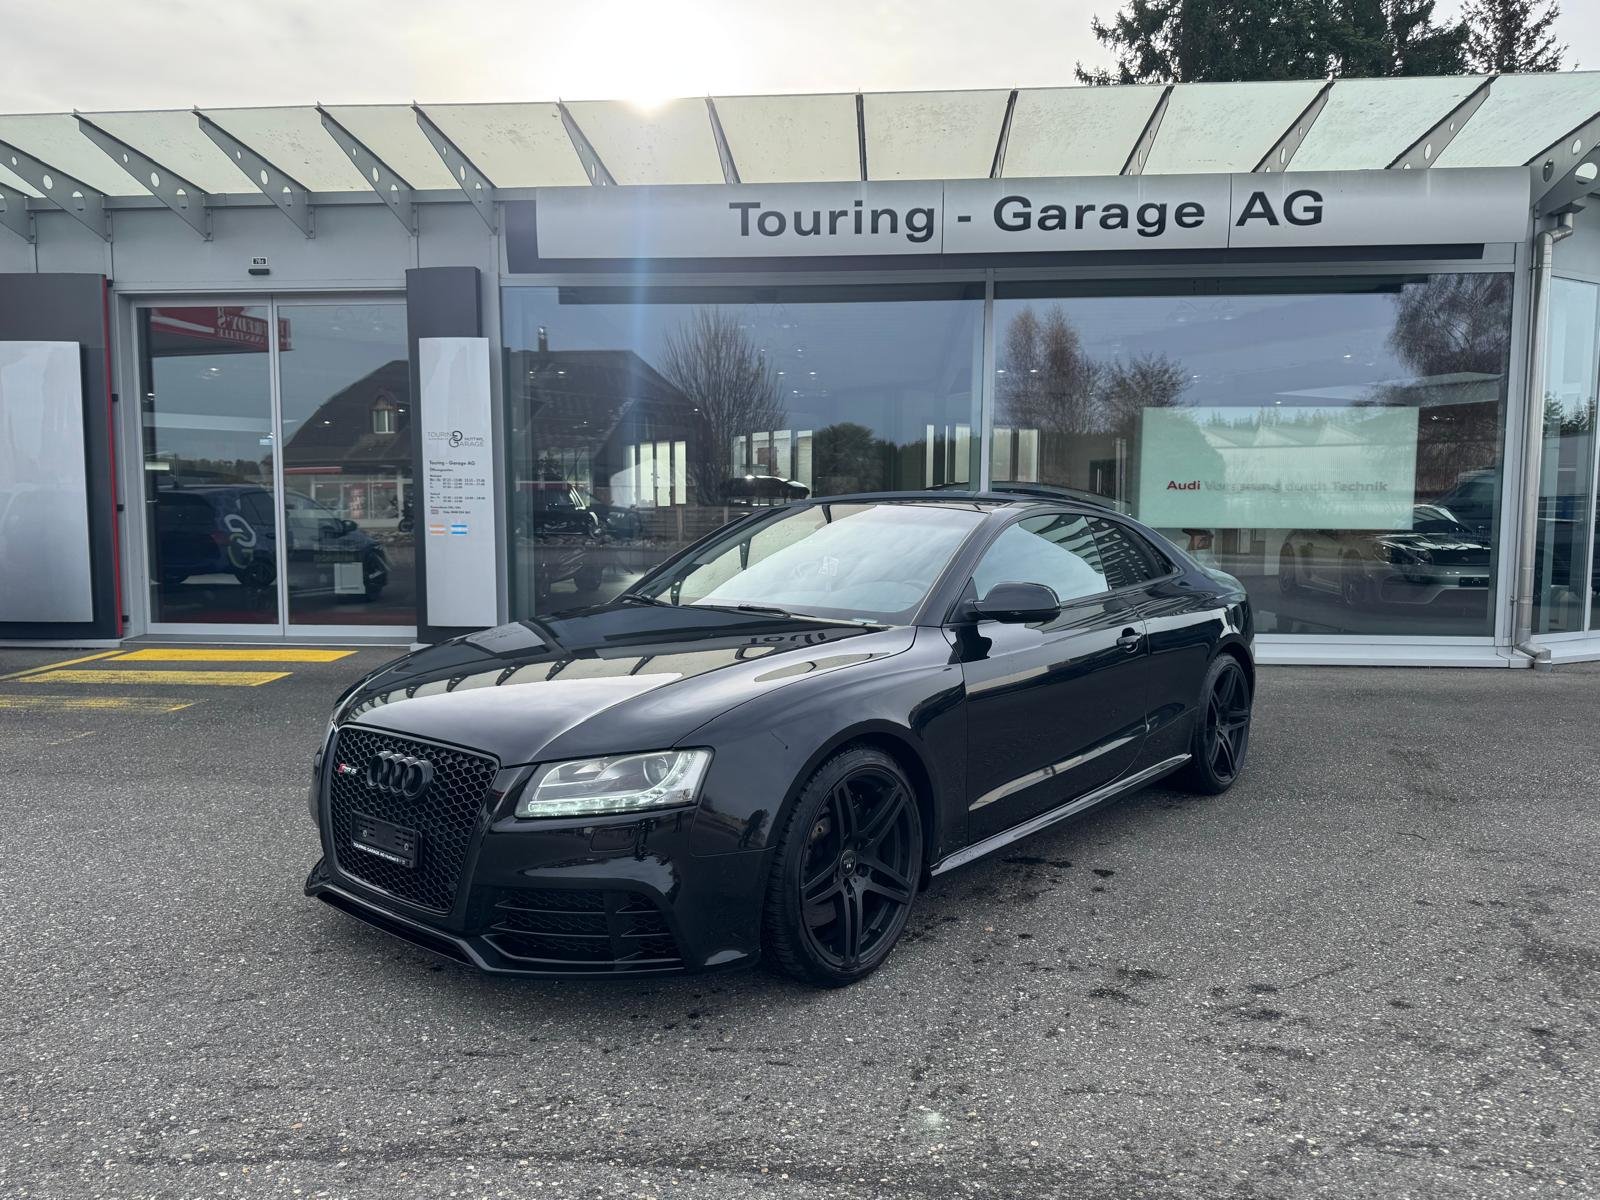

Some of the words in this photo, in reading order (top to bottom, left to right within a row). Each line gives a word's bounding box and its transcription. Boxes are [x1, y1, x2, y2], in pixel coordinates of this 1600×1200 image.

[729, 201, 937, 243] Touring
[956, 214, 972, 223] -
[992, 194, 1206, 238] Garage
[1235, 189, 1325, 228] AG
[1166, 480, 1201, 491] Audi
[1332, 480, 1389, 492] Technik
